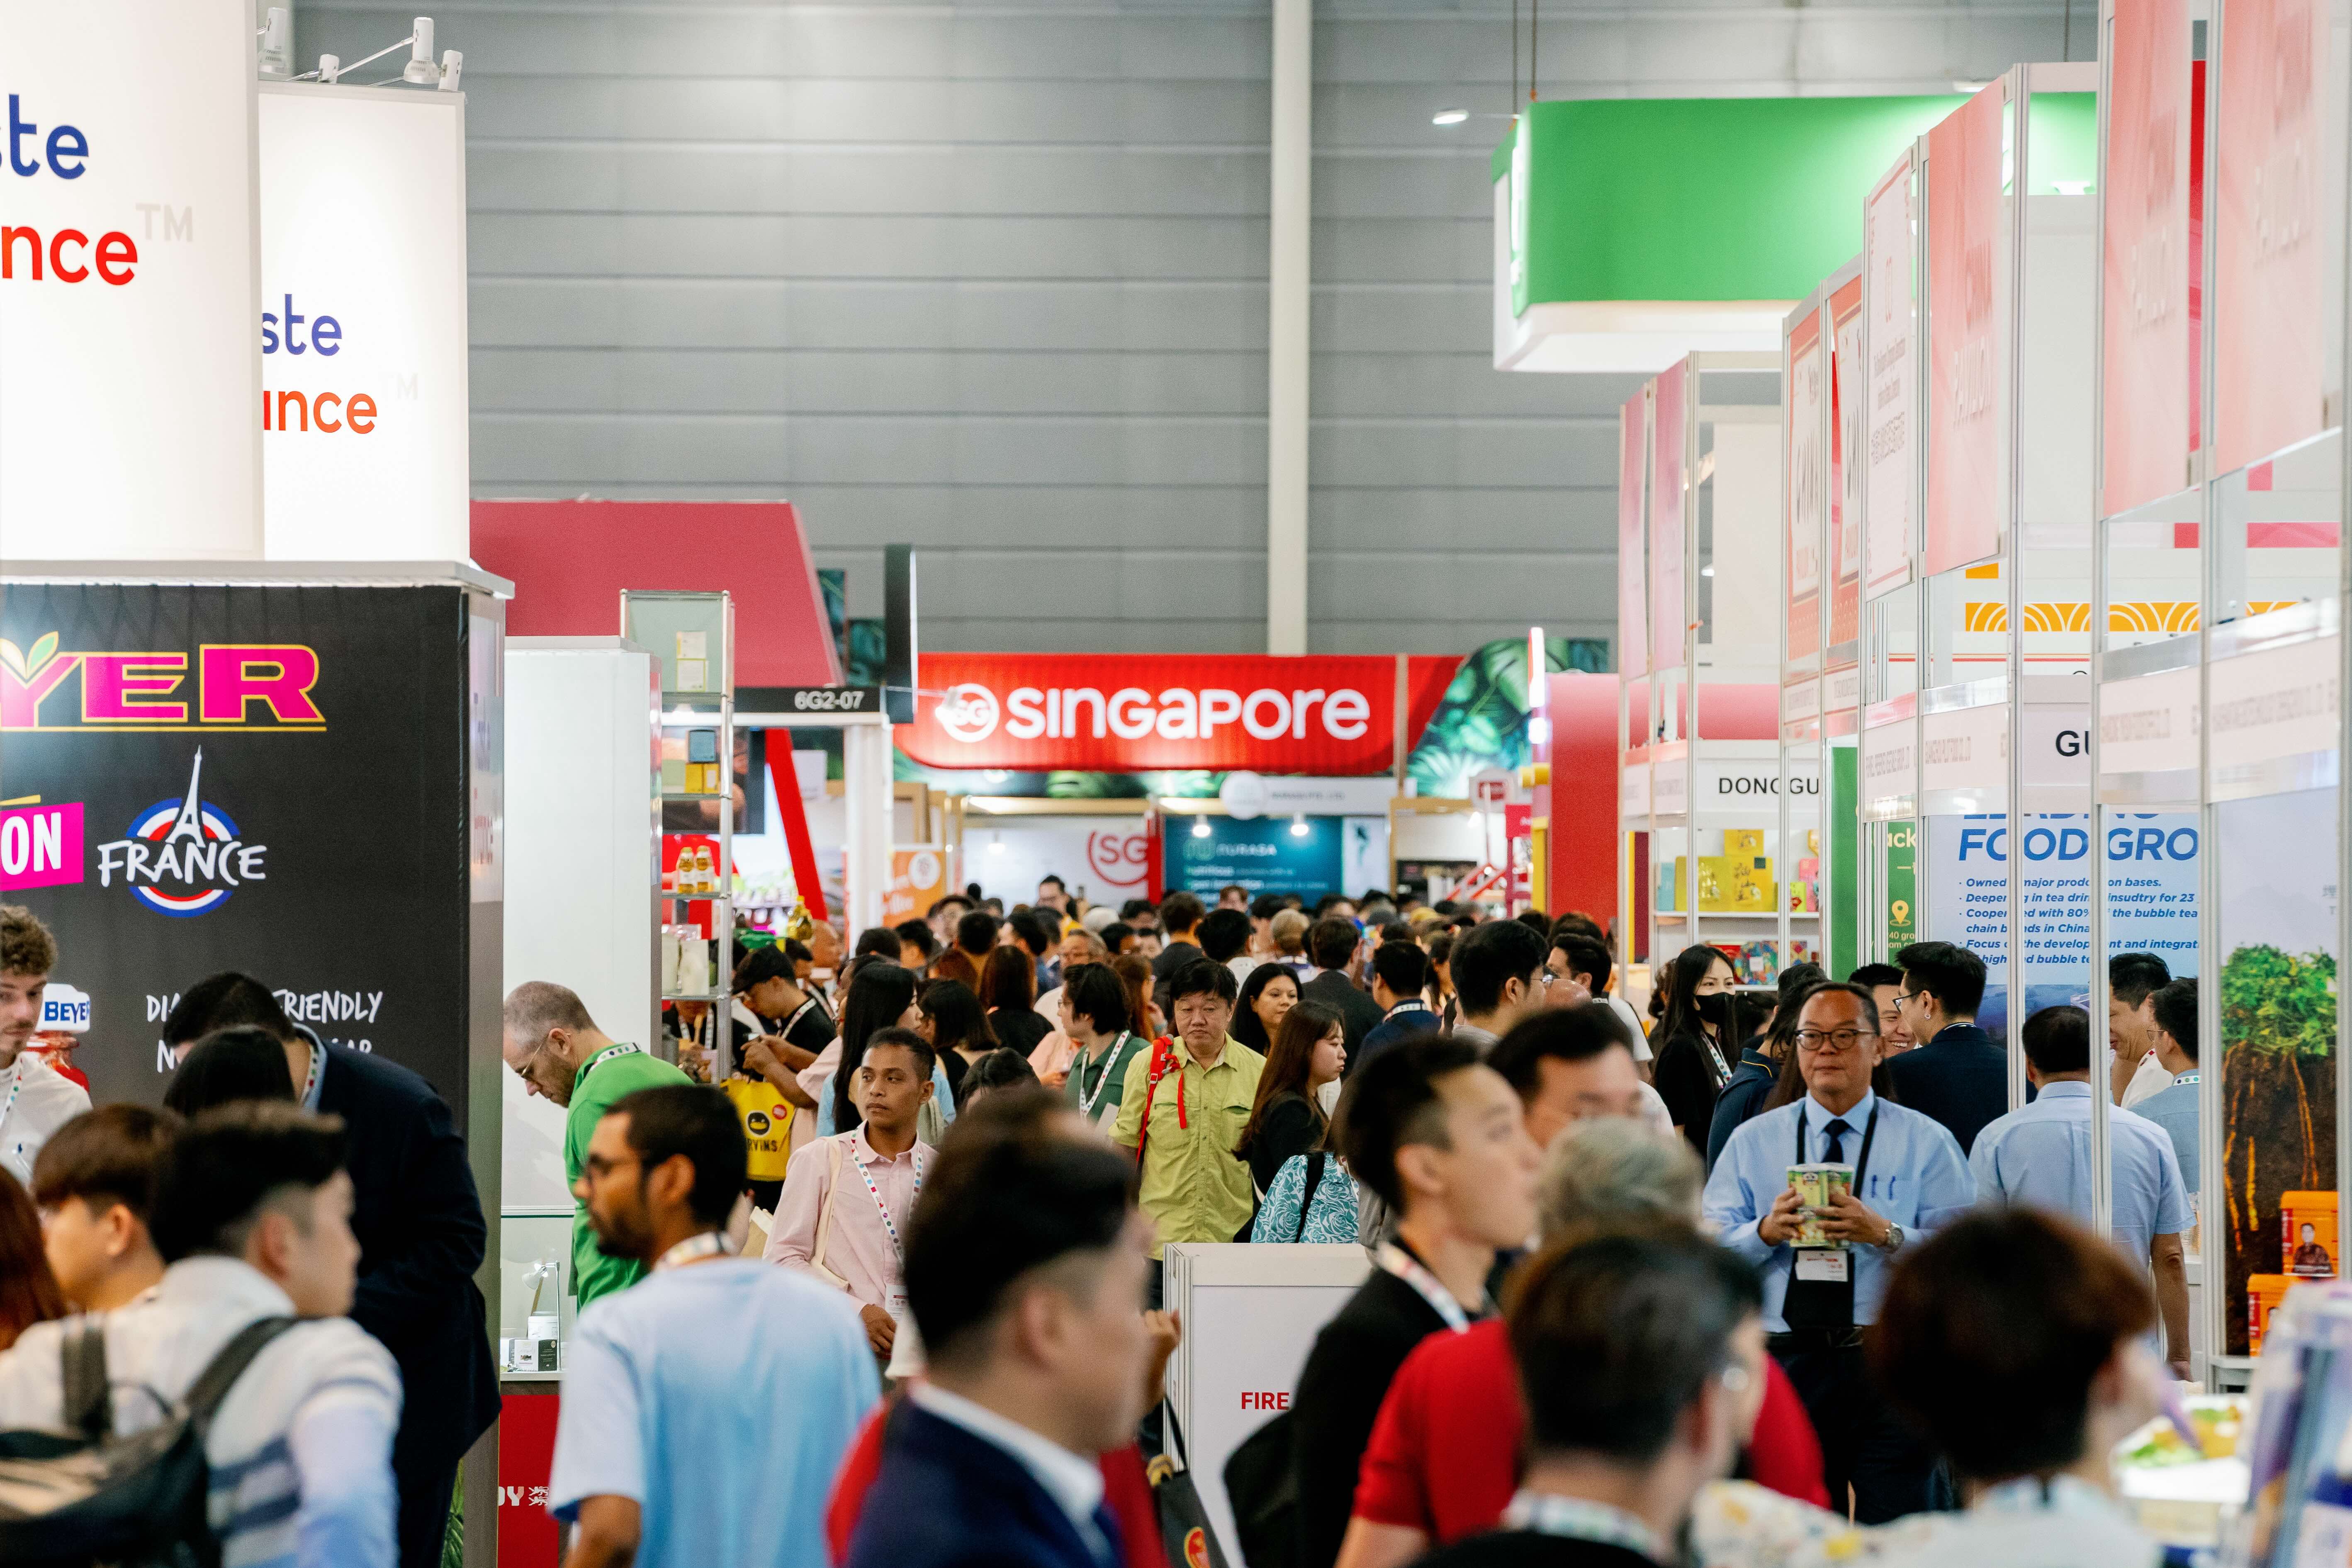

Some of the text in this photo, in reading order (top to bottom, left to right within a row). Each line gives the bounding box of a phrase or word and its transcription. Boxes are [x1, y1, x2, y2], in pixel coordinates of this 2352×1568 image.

[0, 94, 89, 179] te
[263, 391, 377, 434] nce
[795, 691, 865, 710] 6G2-07
[1, 812, 62, 875] ON
[1958, 828, 2199, 861] FOOD GRO
[97, 840, 267, 887] FRANCE
[1966, 878, 2007, 887] Owned
[2125, 878, 2162, 887] bases.
[2031, 893, 2043, 902] in
[2046, 894, 2064, 902] tea
[2067, 893, 2089, 902] drin
[2159, 893, 2177, 902] for
[2179, 894, 2195, 902] 23
[2039, 909, 2064, 917] with
[2113, 909, 2131, 917] the
[2135, 909, 2176, 917] bubble
[1966, 924, 1997, 933] chain
[2044, 924, 2054, 933] in
[1966, 939, 2001, 948] Focus
[2125, 939, 2147, 948] and
[2037, 955, 2078, 963] bubble
[1241, 1392, 1290, 1410] FIRE
